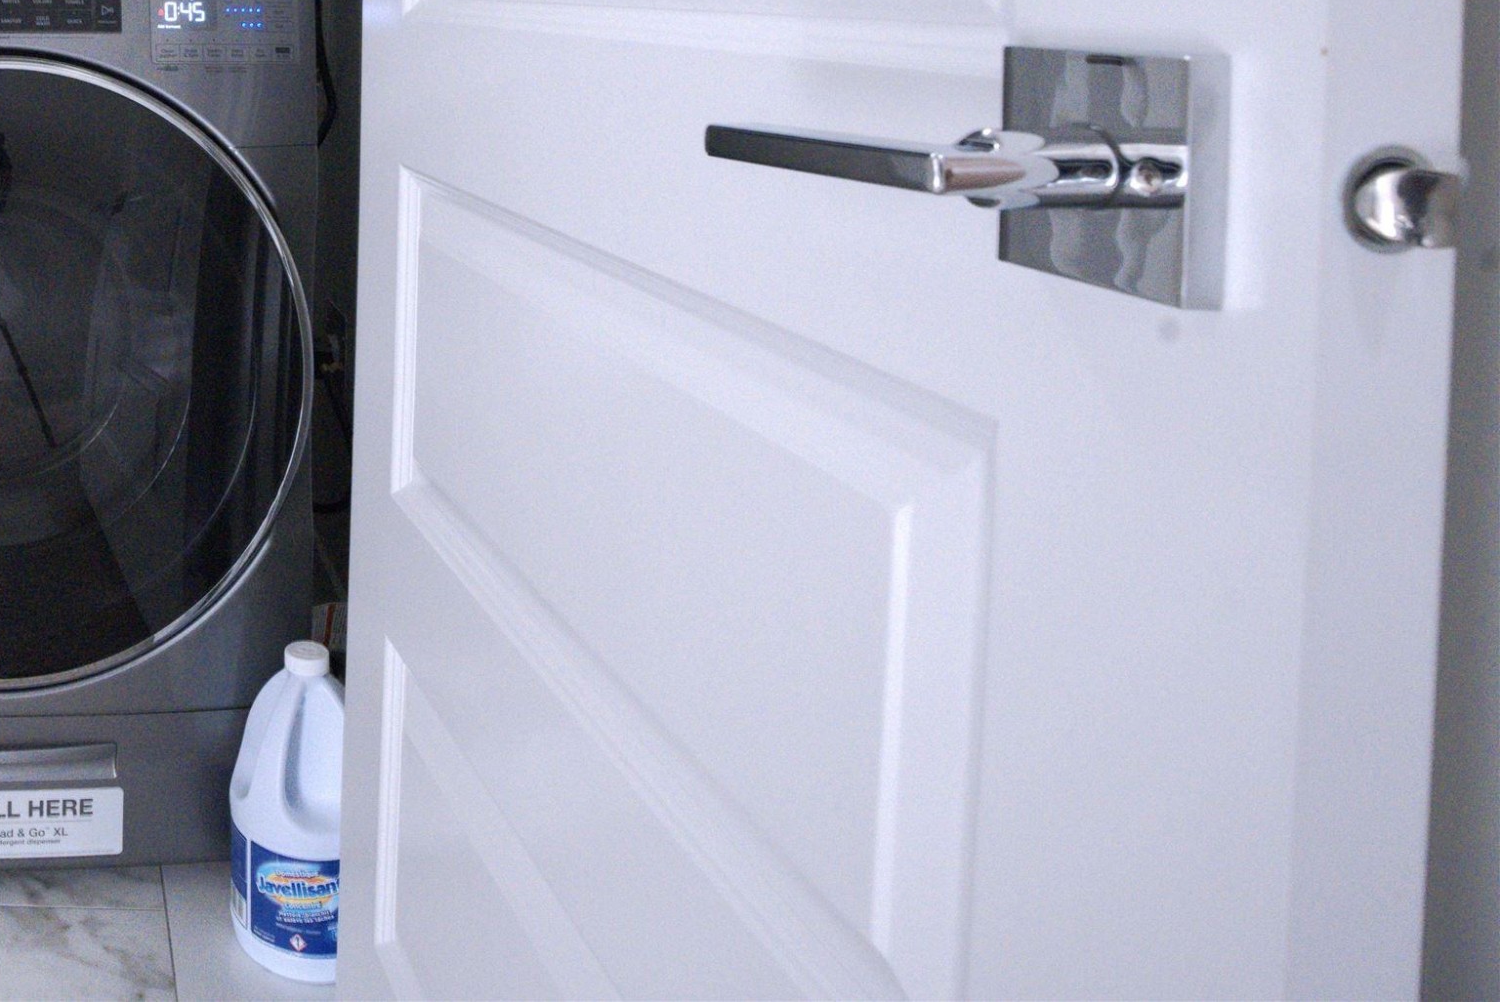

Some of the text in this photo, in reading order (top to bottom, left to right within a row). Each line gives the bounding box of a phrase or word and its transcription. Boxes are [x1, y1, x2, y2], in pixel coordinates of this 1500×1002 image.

[164, 1, 206, 22] 0:45
[29, 798, 94, 817] HERE
[17, 828, 25, 837] &
[53, 827, 69, 836] XL
